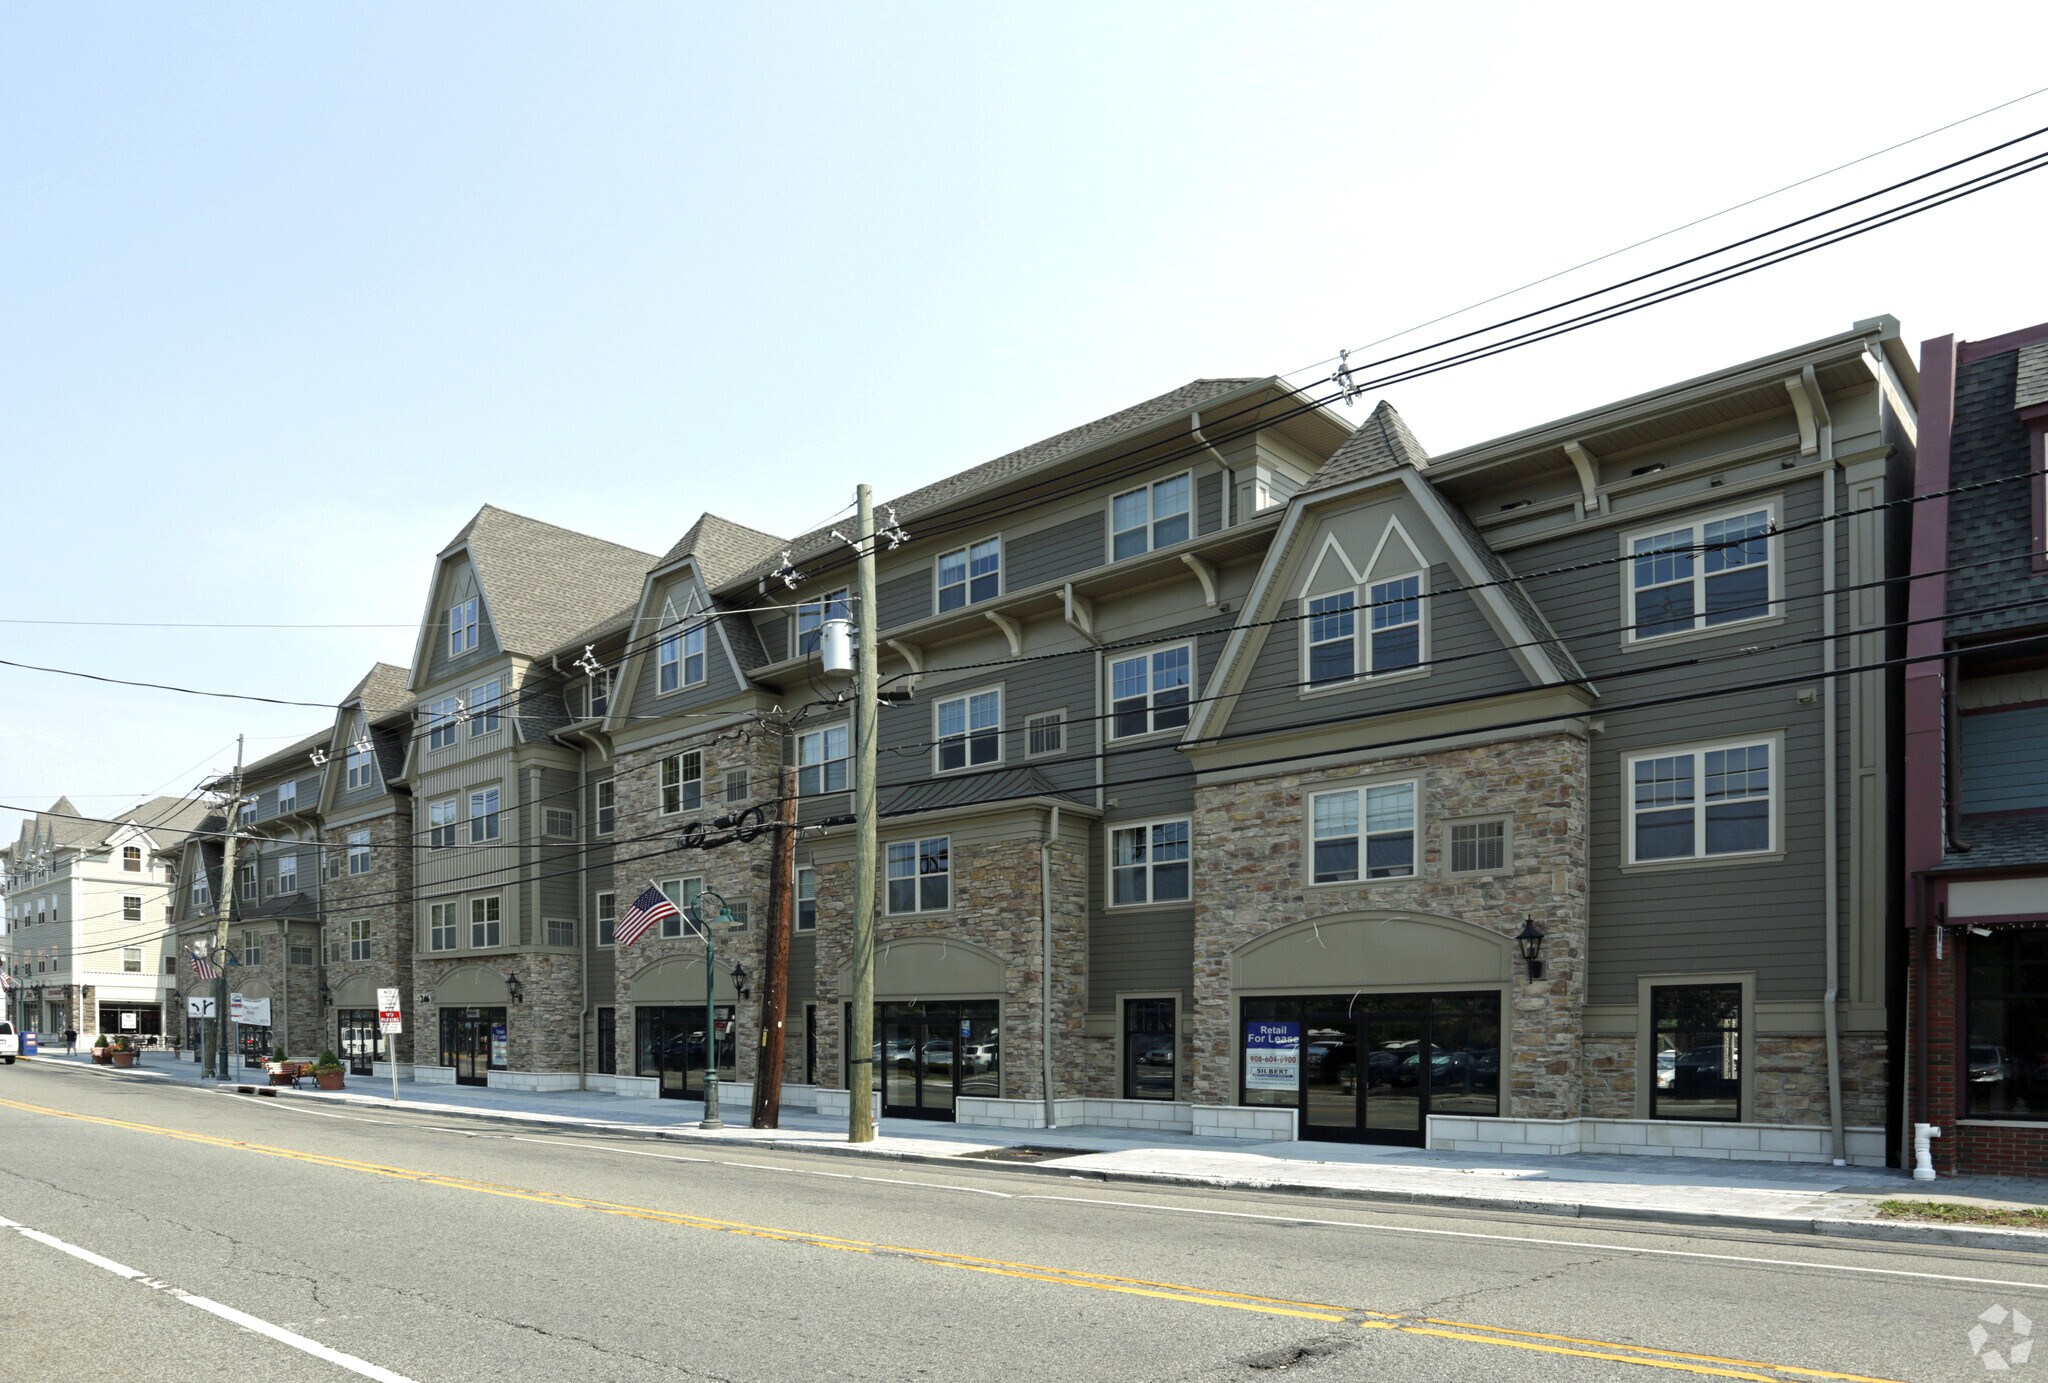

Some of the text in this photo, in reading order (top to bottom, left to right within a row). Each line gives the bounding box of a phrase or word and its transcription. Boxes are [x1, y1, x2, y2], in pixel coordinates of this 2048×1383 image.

[1260, 1025, 1287, 1035] Retail
[1247, 1033, 1300, 1044] For Lease
[1249, 1055, 1297, 1064] 908-604-6900
